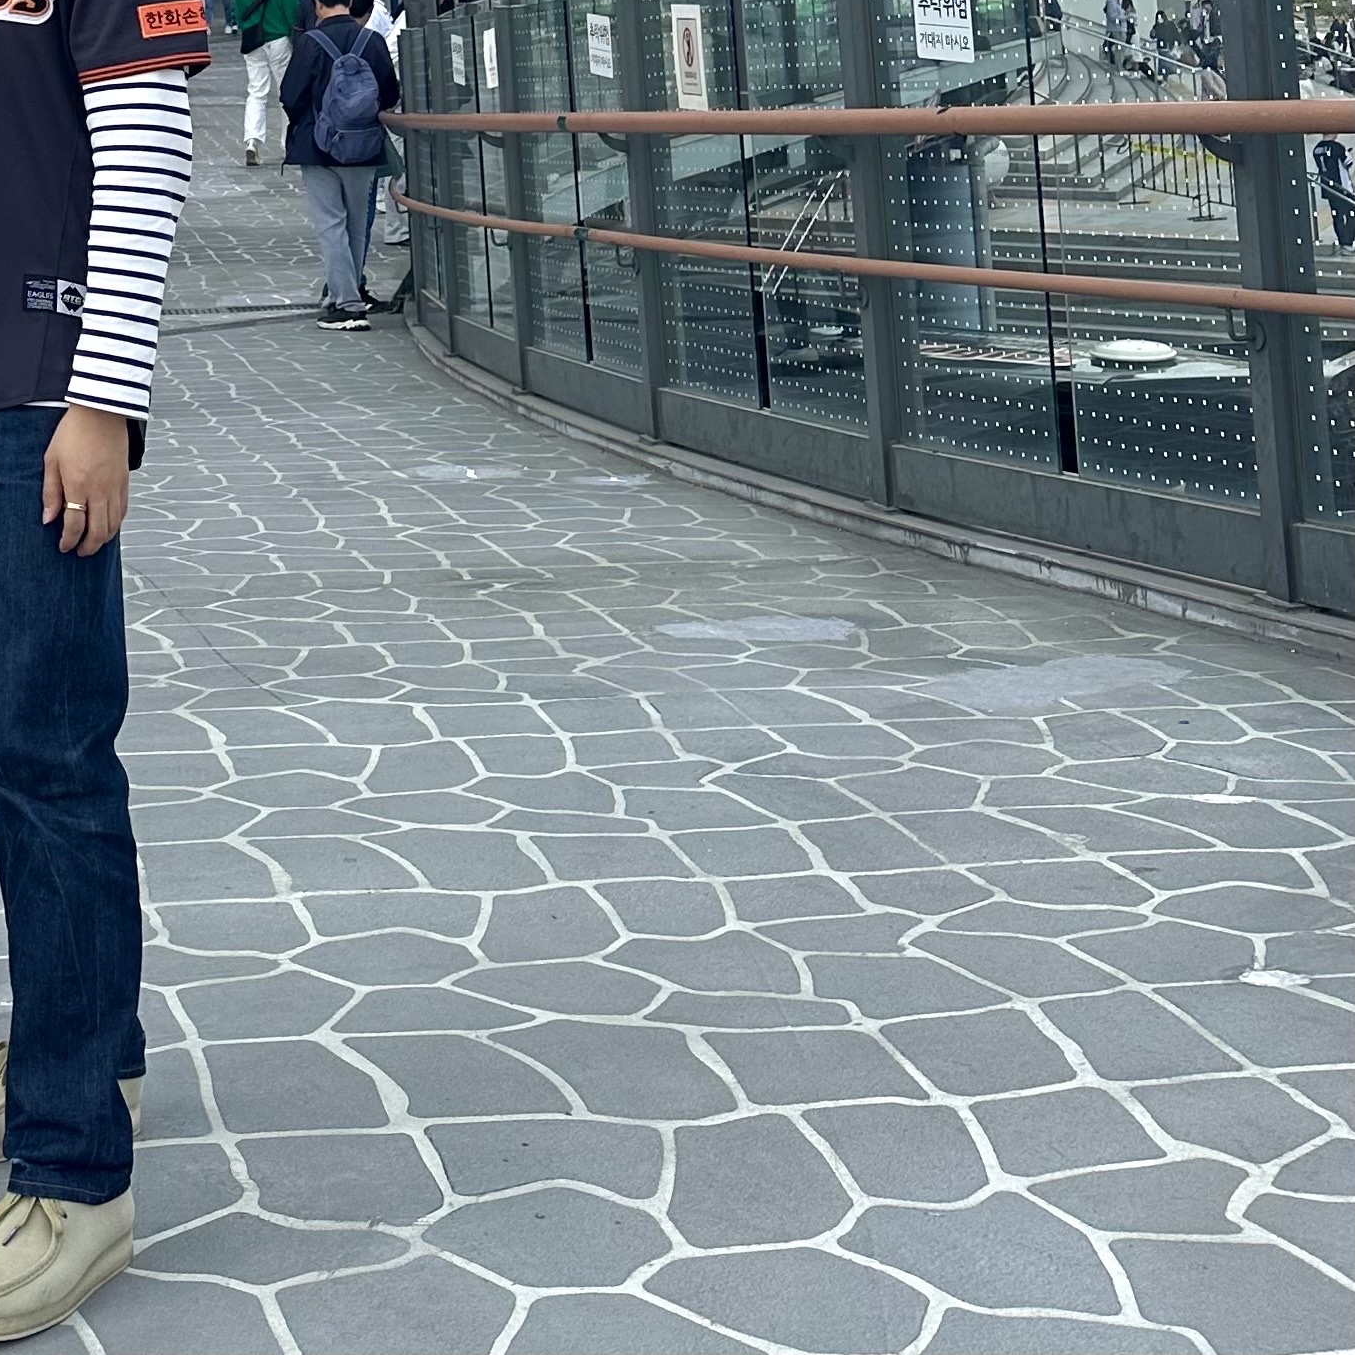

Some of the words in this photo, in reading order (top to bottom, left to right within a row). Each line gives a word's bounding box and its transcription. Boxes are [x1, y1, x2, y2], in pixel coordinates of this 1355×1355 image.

[919, 30, 944, 49] 기대지
[945, 33, 971, 51] 마시오
[27, 290, 54, 300] EAGLES
